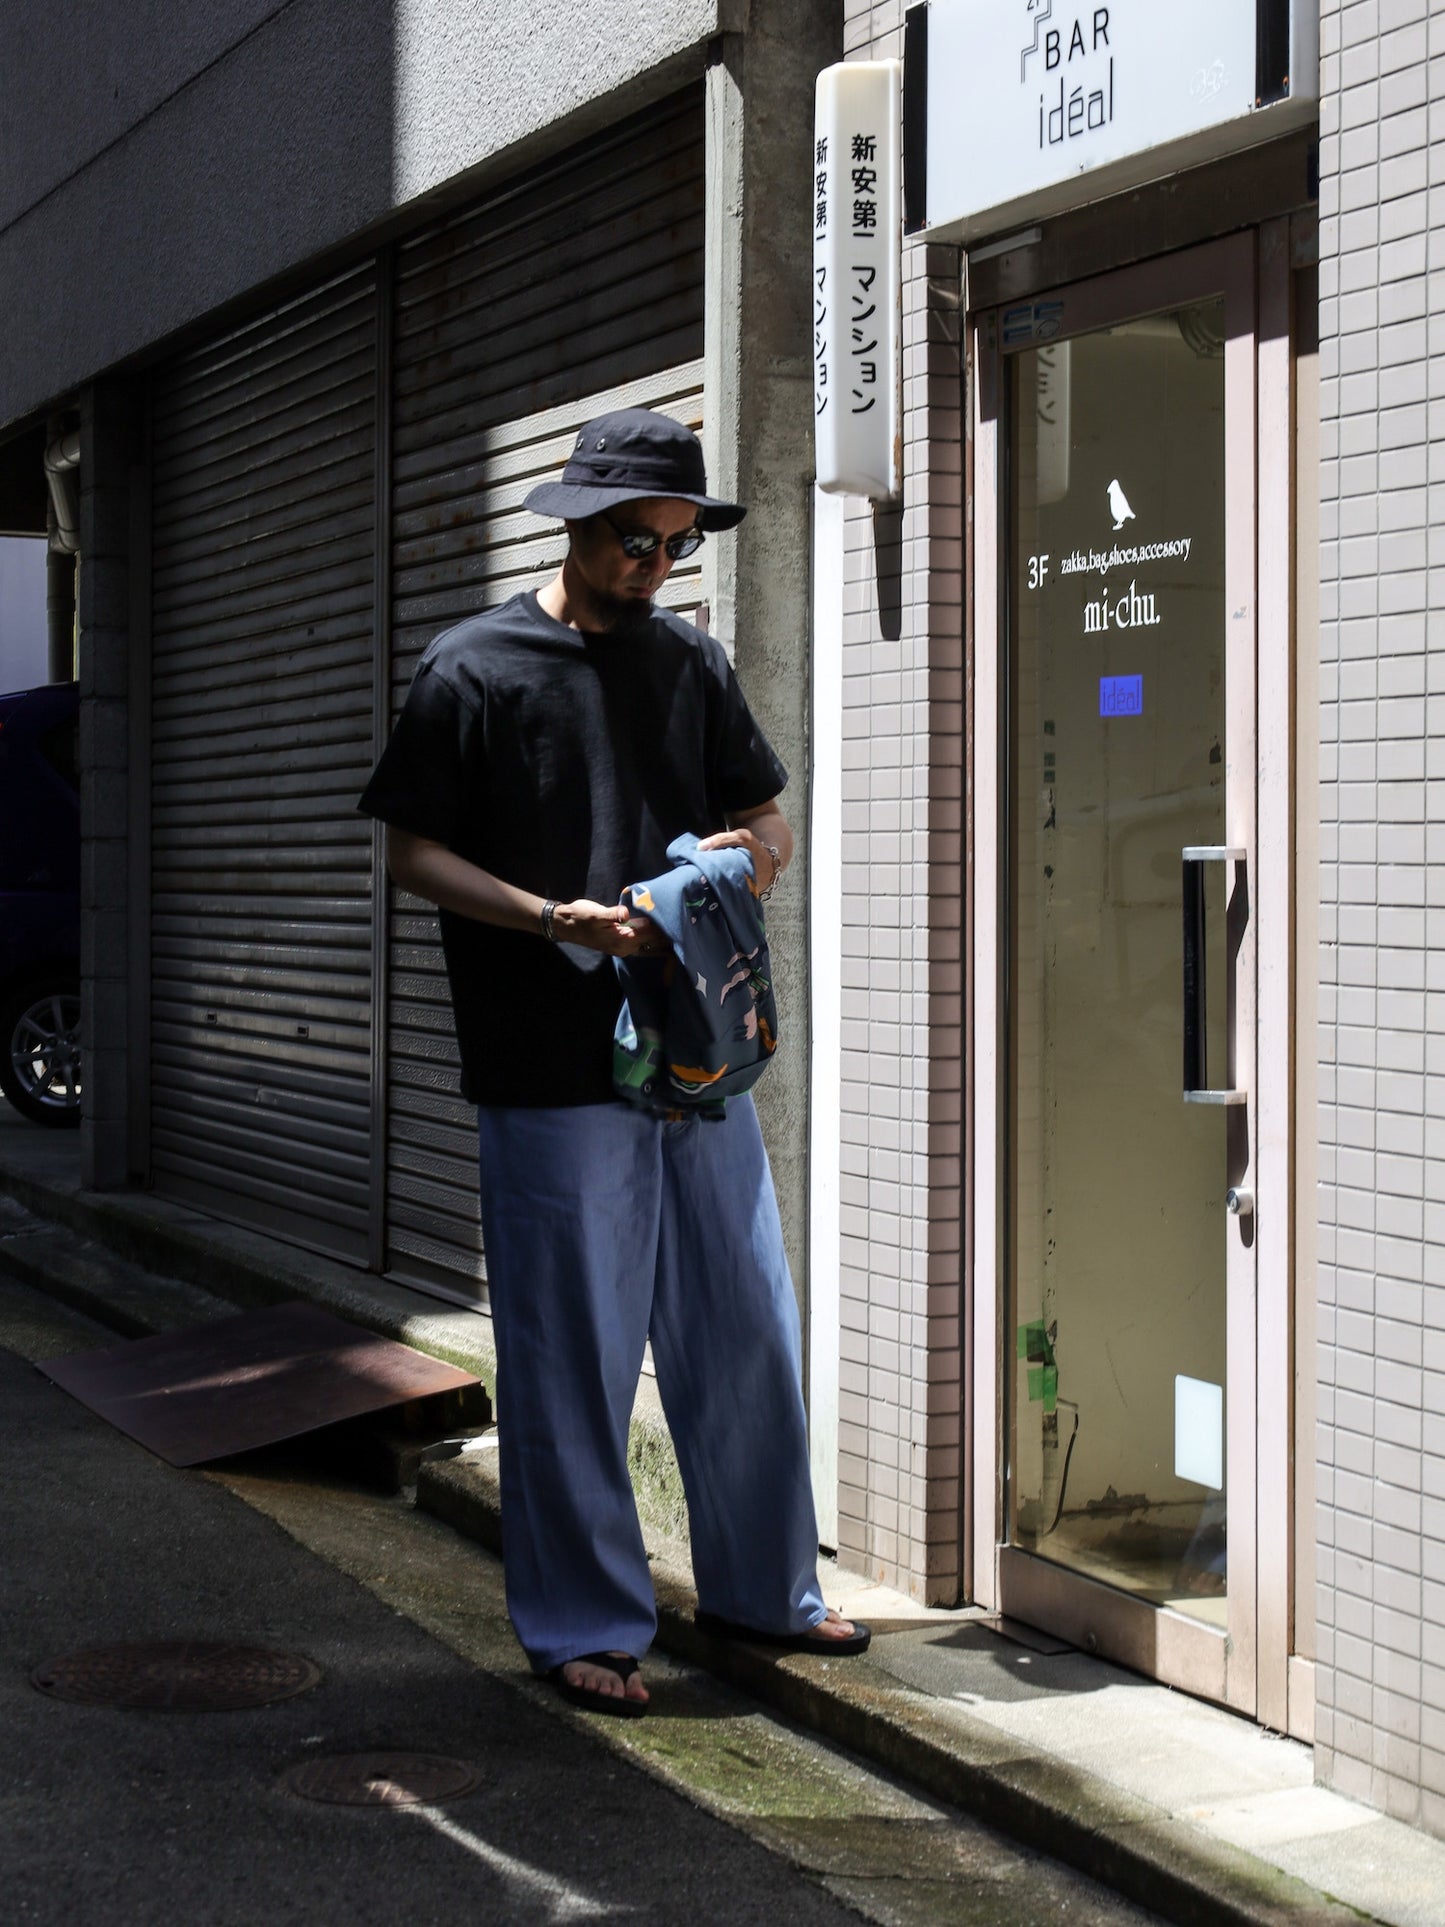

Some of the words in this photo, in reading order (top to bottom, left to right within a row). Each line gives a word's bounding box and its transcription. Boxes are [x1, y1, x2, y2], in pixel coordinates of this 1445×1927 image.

[1045, 8, 1110, 71] BAR
[1039, 56, 1114, 149] idéal
[851, 133, 877, 238] 新安第一
[851, 266, 878, 413] マンション
[1027, 554, 1050, 590] 3F
[1083, 579, 1161, 634] mi-chu.
